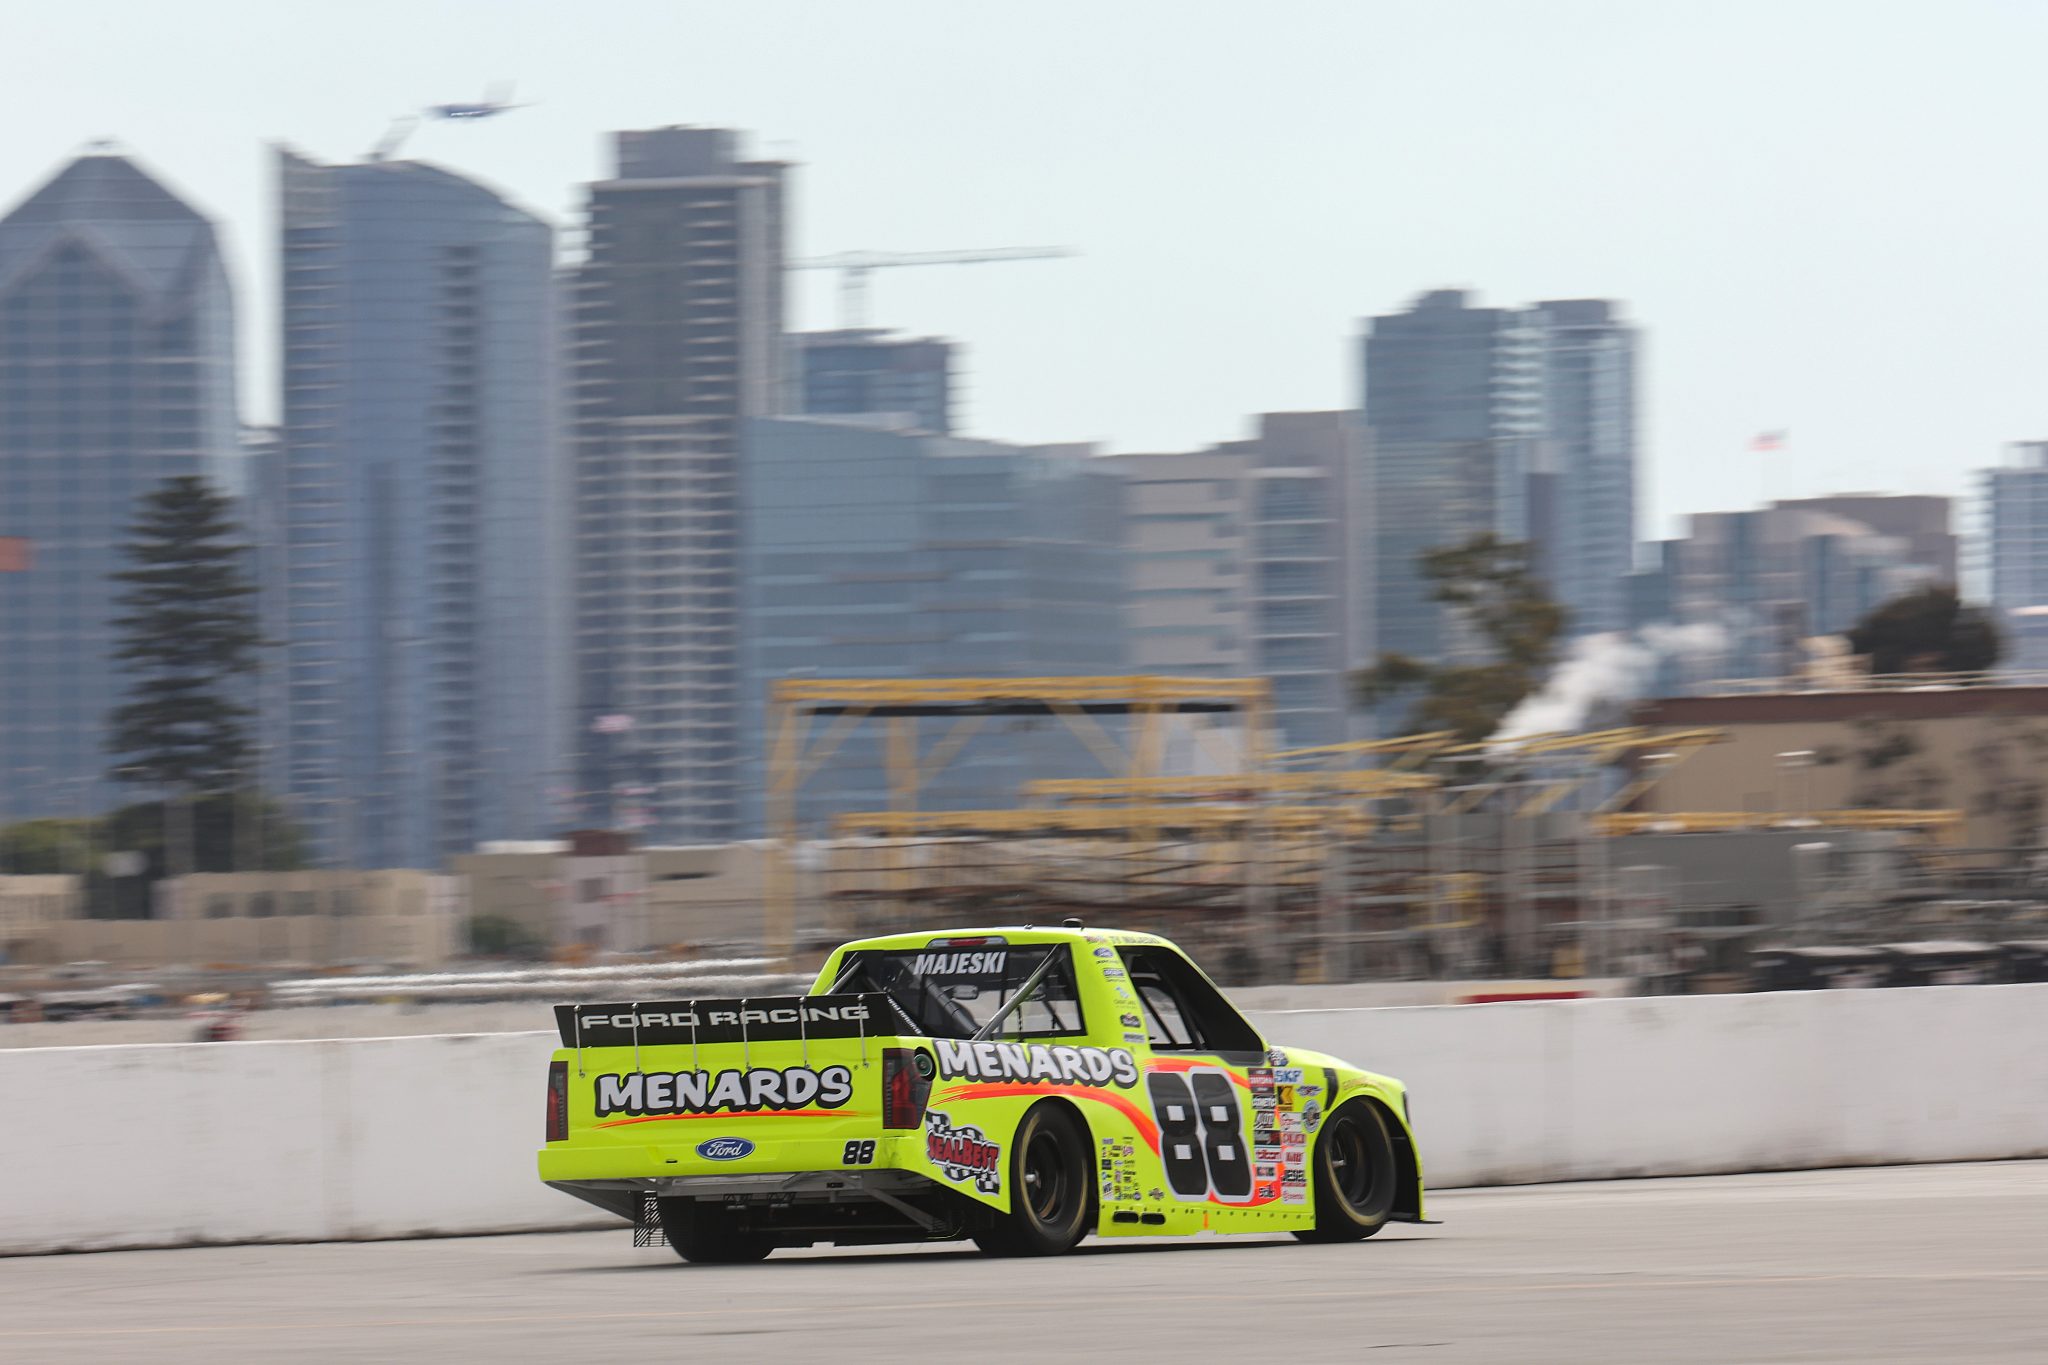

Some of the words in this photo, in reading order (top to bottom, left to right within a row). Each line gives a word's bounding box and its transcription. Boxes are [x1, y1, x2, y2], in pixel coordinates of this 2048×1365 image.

[913, 952, 1007, 975] MAJESKI
[581, 1011, 702, 1029] FORD
[709, 1005, 871, 1027] RACING
[934, 1040, 1138, 1089] MENARDS
[1274, 1069, 1301, 1083] SKF
[595, 1065, 853, 1117] MENARDS
[1149, 1069, 1252, 1199] 88
[706, 1141, 743, 1157] Ford
[842, 1140, 876, 1165] 88
